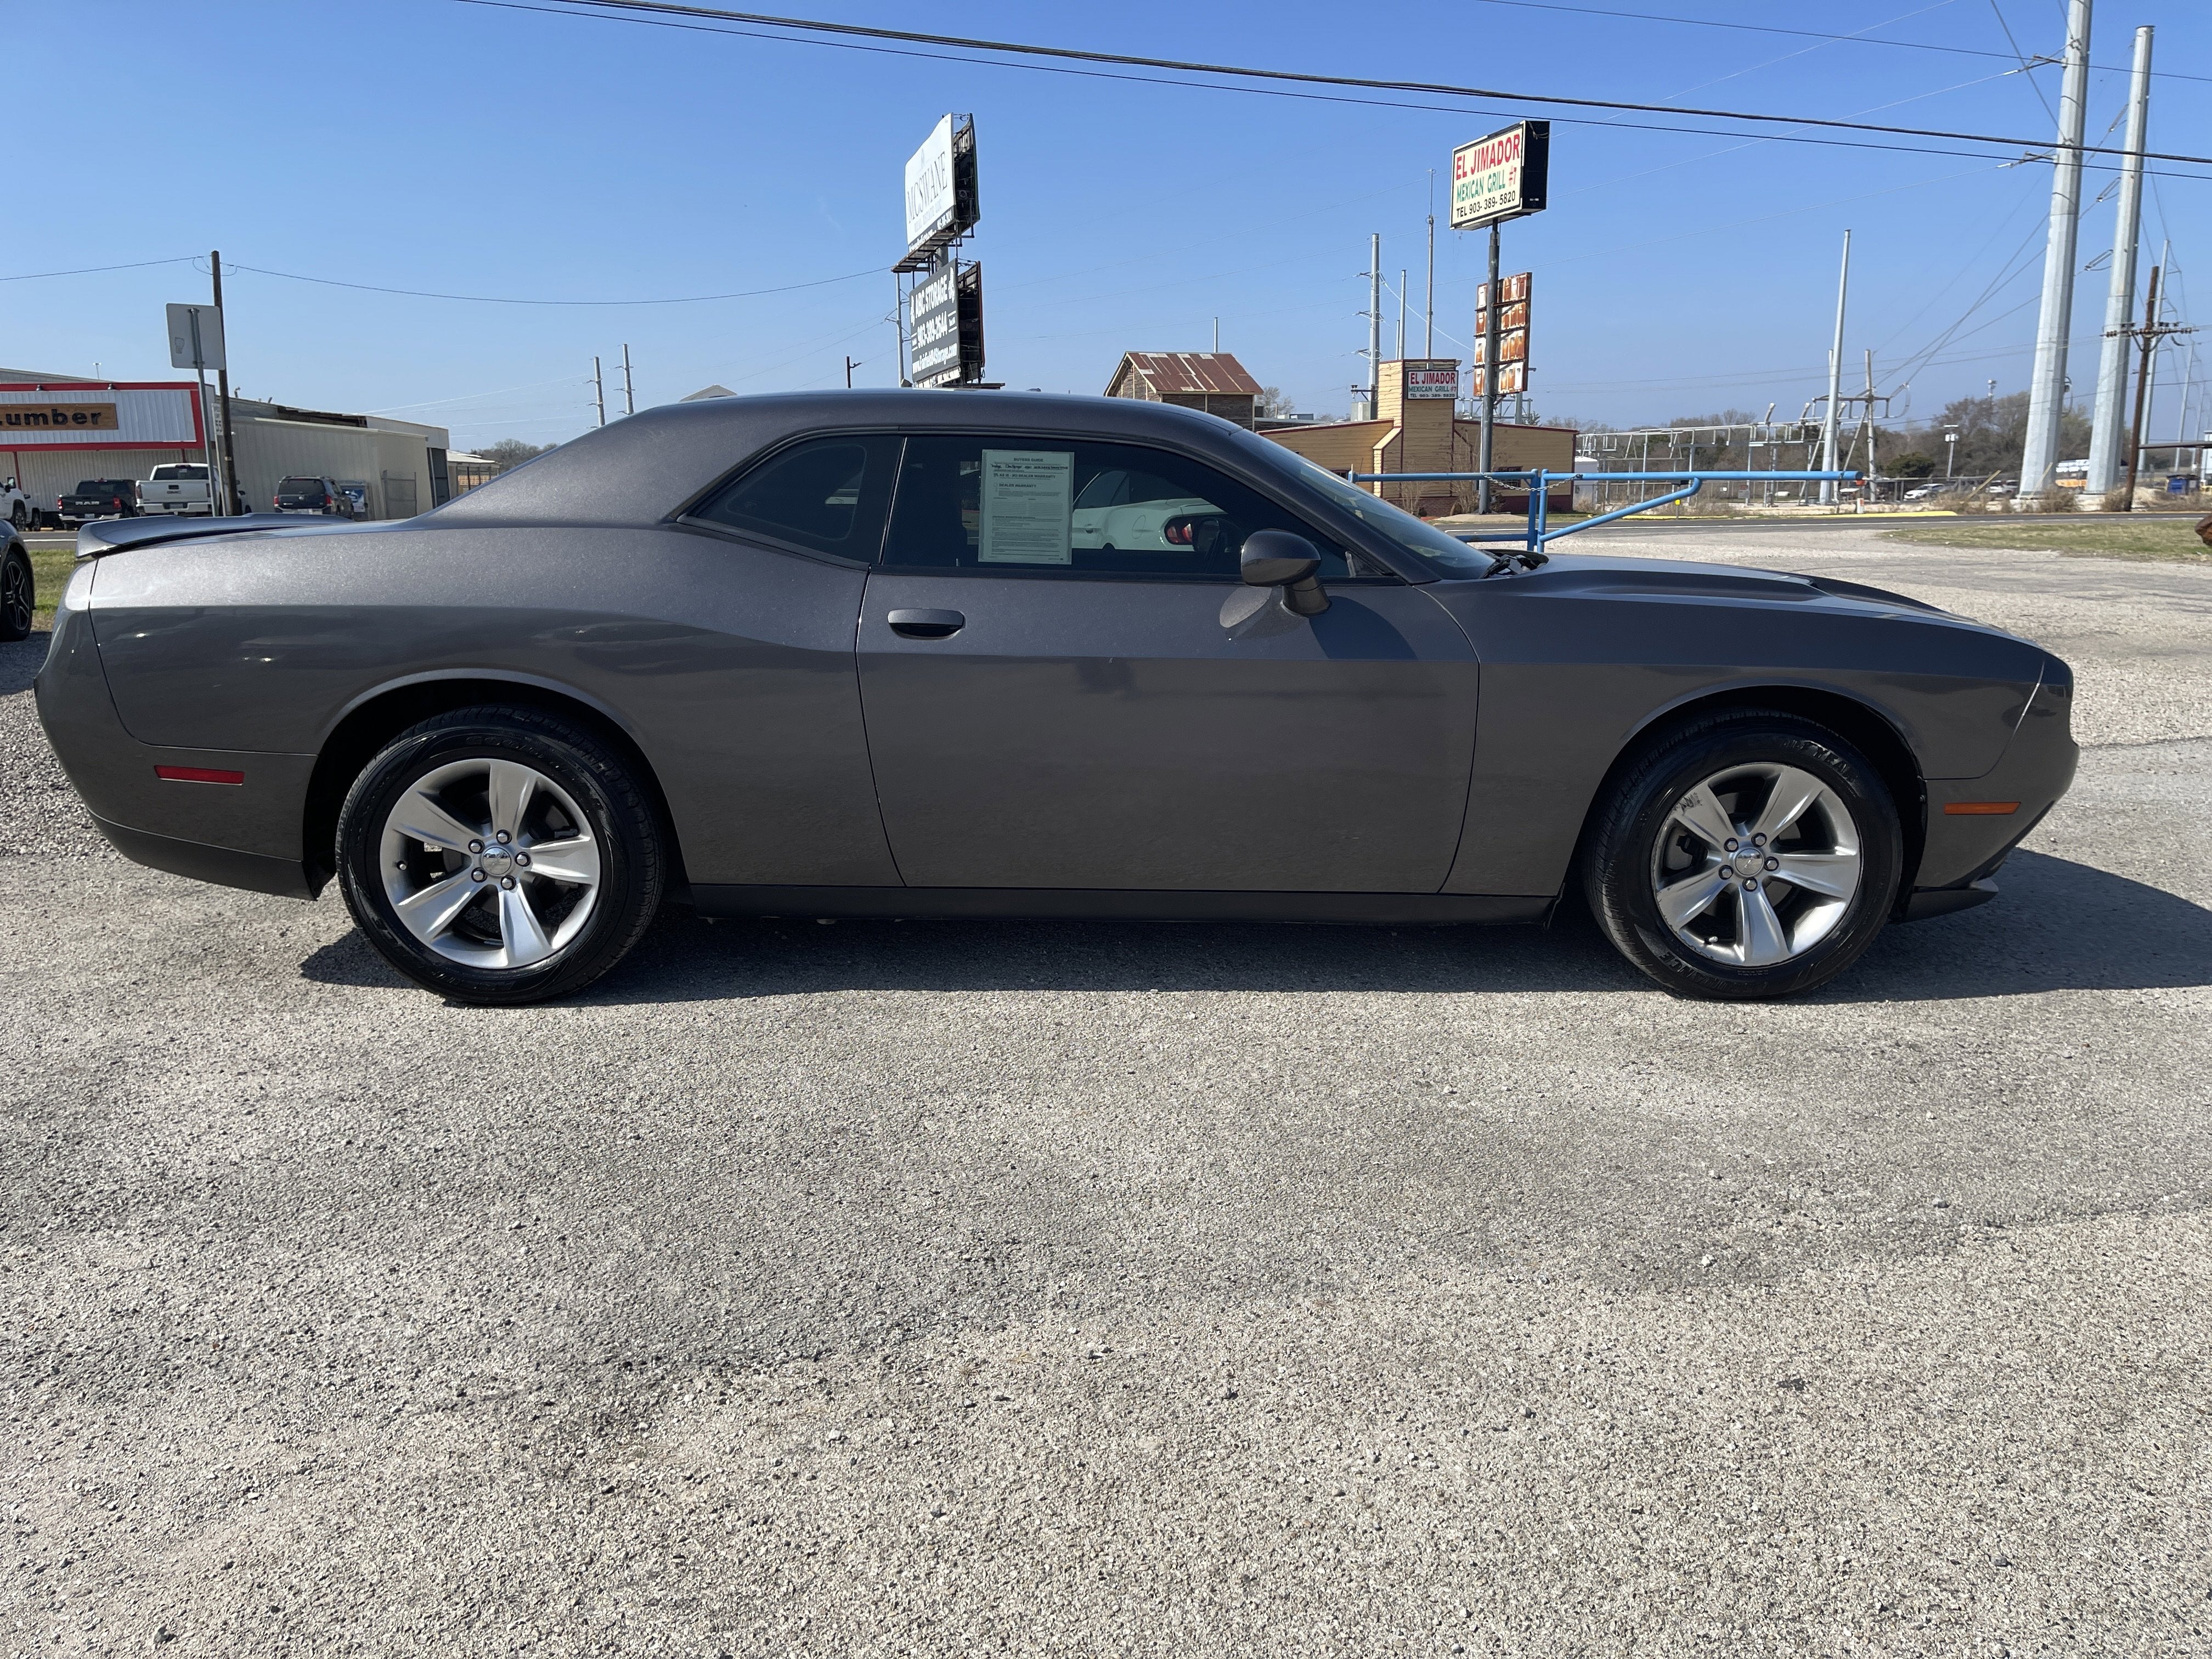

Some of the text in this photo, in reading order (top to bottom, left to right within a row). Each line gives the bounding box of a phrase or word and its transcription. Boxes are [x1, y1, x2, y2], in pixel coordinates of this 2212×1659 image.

[1455, 133, 1520, 181] EL JIMADOR
[1456, 166, 1517, 204] MEXICAN GRILL #7
[1456, 206, 1468, 218] TEL
[1499, 190, 1516, 206] 5820
[915, 274, 949, 319] ABC STORAGE
[1410, 373, 1455, 385] EL JIMADOR
[0, 409, 102, 426] umber
